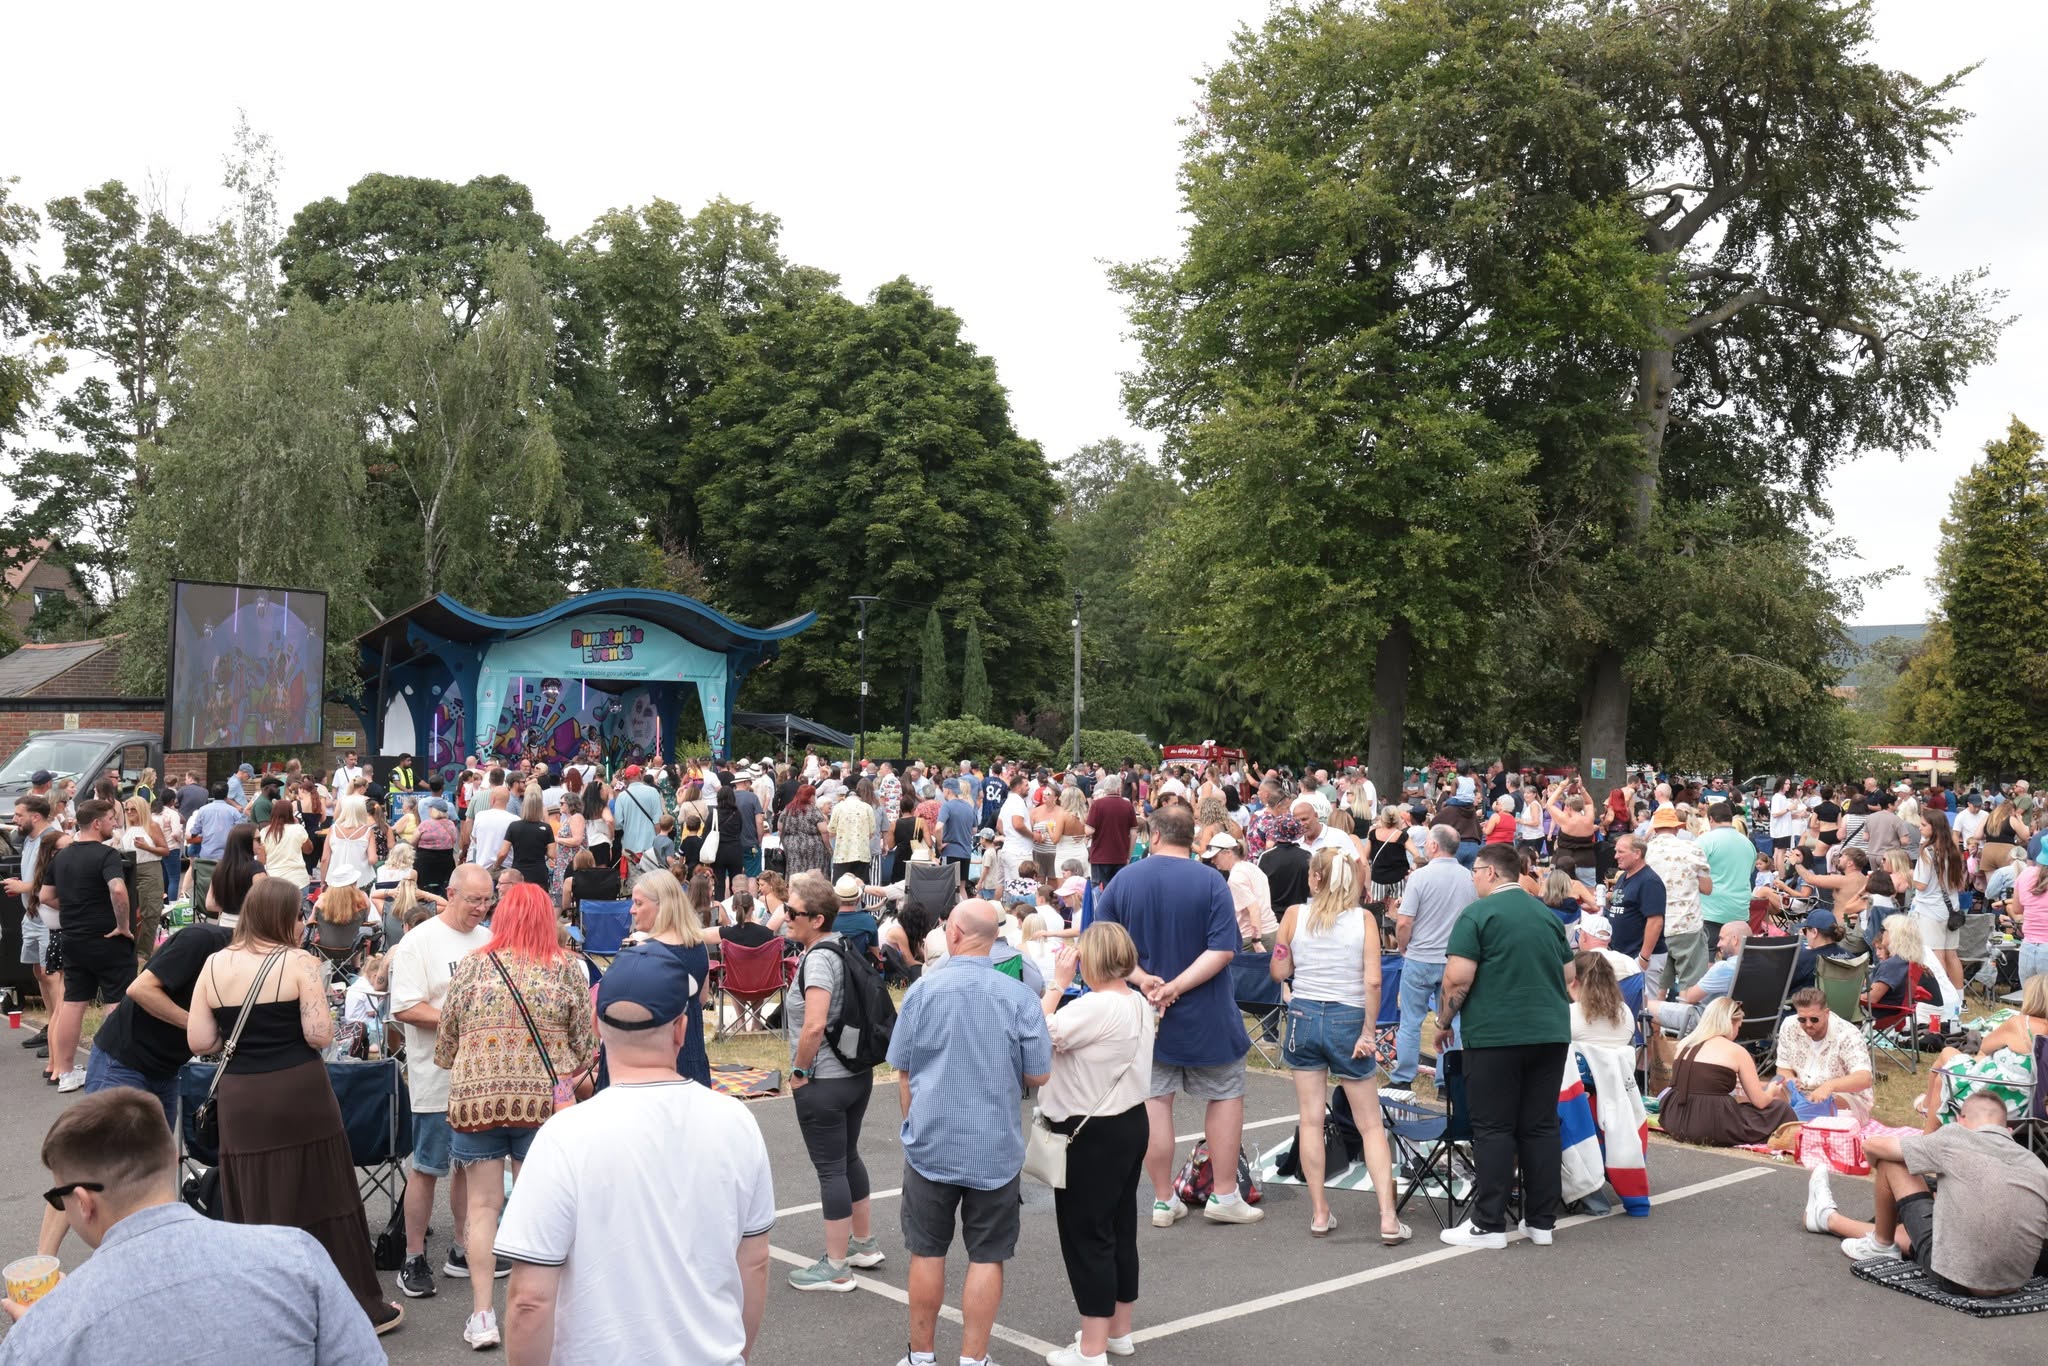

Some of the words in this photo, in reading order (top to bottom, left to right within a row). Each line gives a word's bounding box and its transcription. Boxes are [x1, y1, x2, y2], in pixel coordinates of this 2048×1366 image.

[571, 625, 644, 648] Dunstable
[583, 644, 633, 663] Events
[986, 785, 1002, 804] 84
